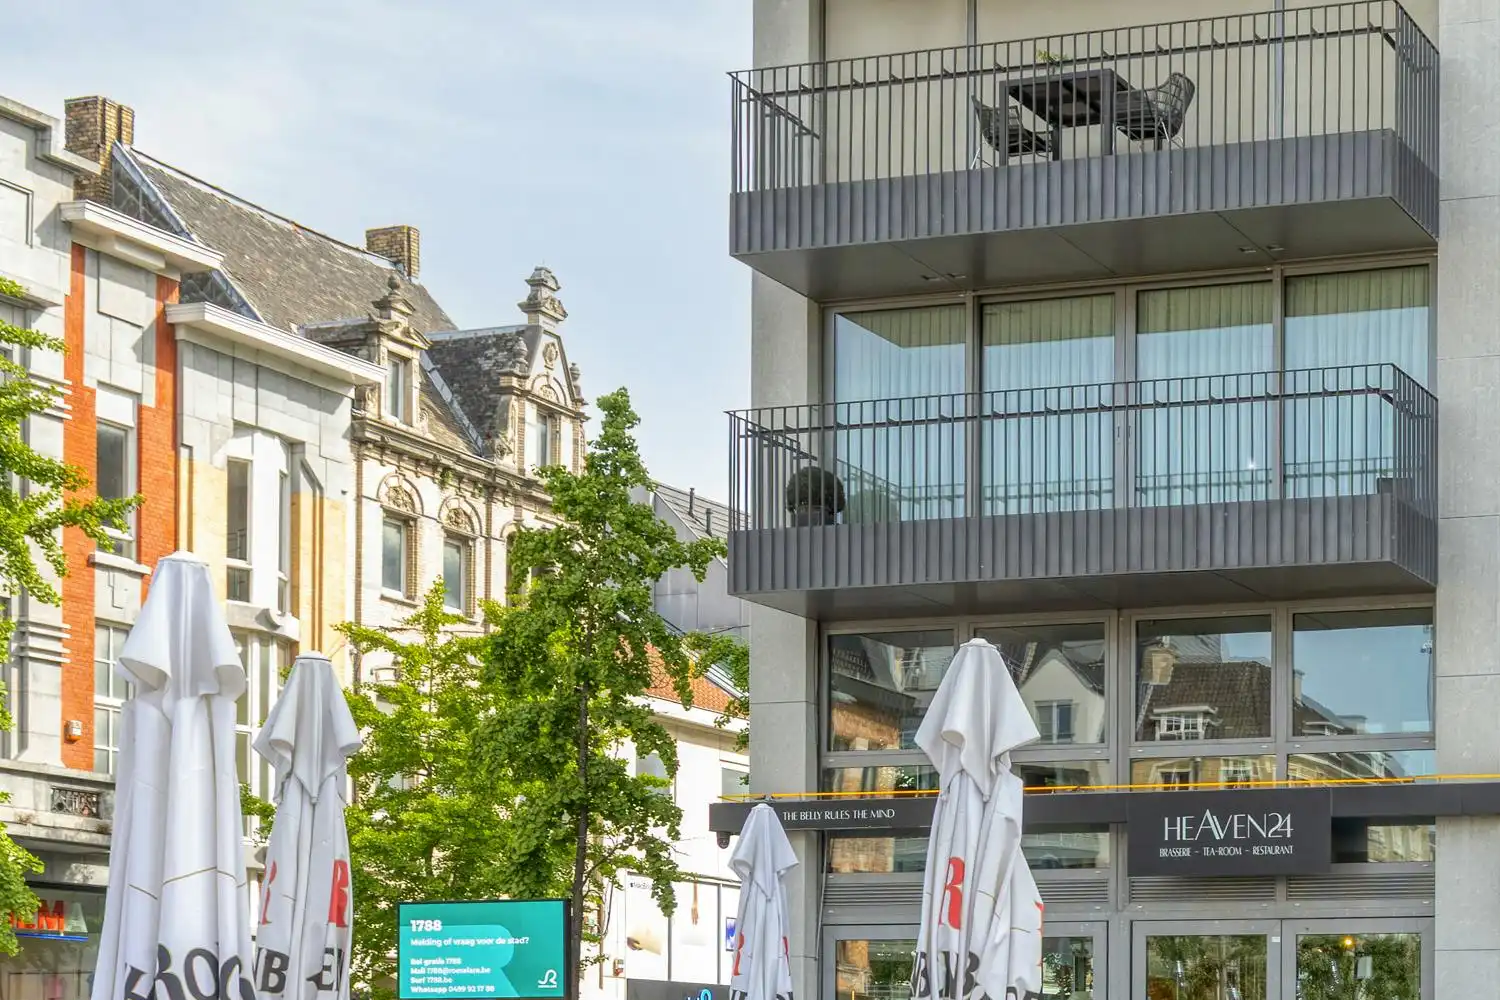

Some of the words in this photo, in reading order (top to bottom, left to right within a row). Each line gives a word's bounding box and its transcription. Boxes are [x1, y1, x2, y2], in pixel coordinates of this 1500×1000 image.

[783, 811, 798, 821] THE
[800, 810, 822, 821] BELLY
[824, 809, 850, 820] RULES
[852, 809, 868, 819] THE
[869, 808, 896, 819] MIND
[1163, 808, 1295, 841] HEAVEN24
[1159, 847, 1191, 857] BRASSERIE
[1203, 846, 1242, 857] TEA-ROOM
[1252, 845, 1293, 855] RESTAURANT
[410, 919, 442, 933] 1788
[443, 937, 452, 946] of
[453, 939, 476, 948] vraag
[477, 938, 495, 946] voor
[496, 937, 506, 945] de
[507, 936, 530, 945] stad?
[410, 967, 426, 975] Mail
[410, 976, 426, 984] Surf
